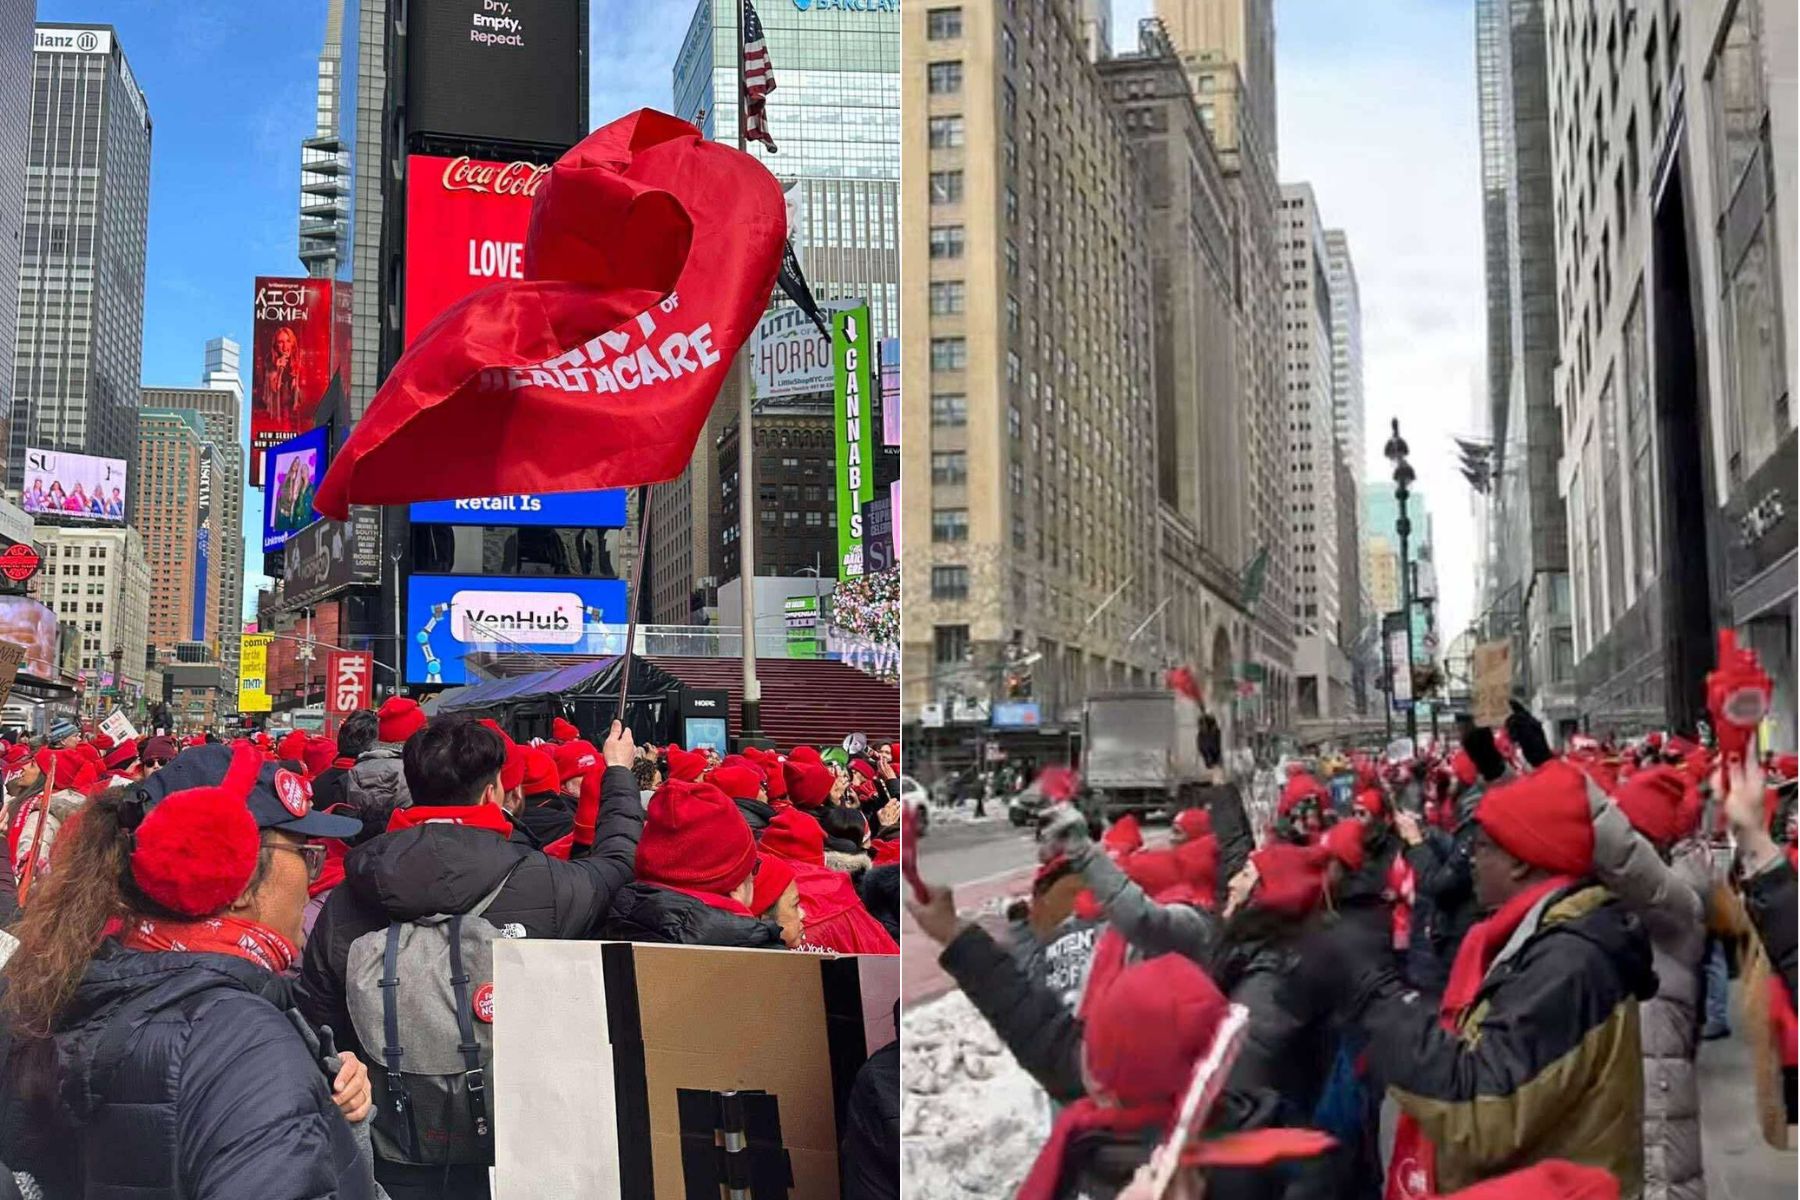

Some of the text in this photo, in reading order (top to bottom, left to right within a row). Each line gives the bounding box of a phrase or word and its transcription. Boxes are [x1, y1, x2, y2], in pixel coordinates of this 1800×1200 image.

[484, 0, 511, 15] Dry.
[473, 13, 522, 33] Empty.
[470, 30, 525, 46] Repeat.
[469, 239, 524, 279] LOVE
[659, 291, 679, 313] OF
[256, 307, 309, 321] WOMEN
[845, 348, 863, 538] CANNABIS
[29, 452, 56, 471] SU
[520, 495, 541, 511] Is
[466, 606, 569, 631] VenHub
[337, 655, 366, 711] tkts
